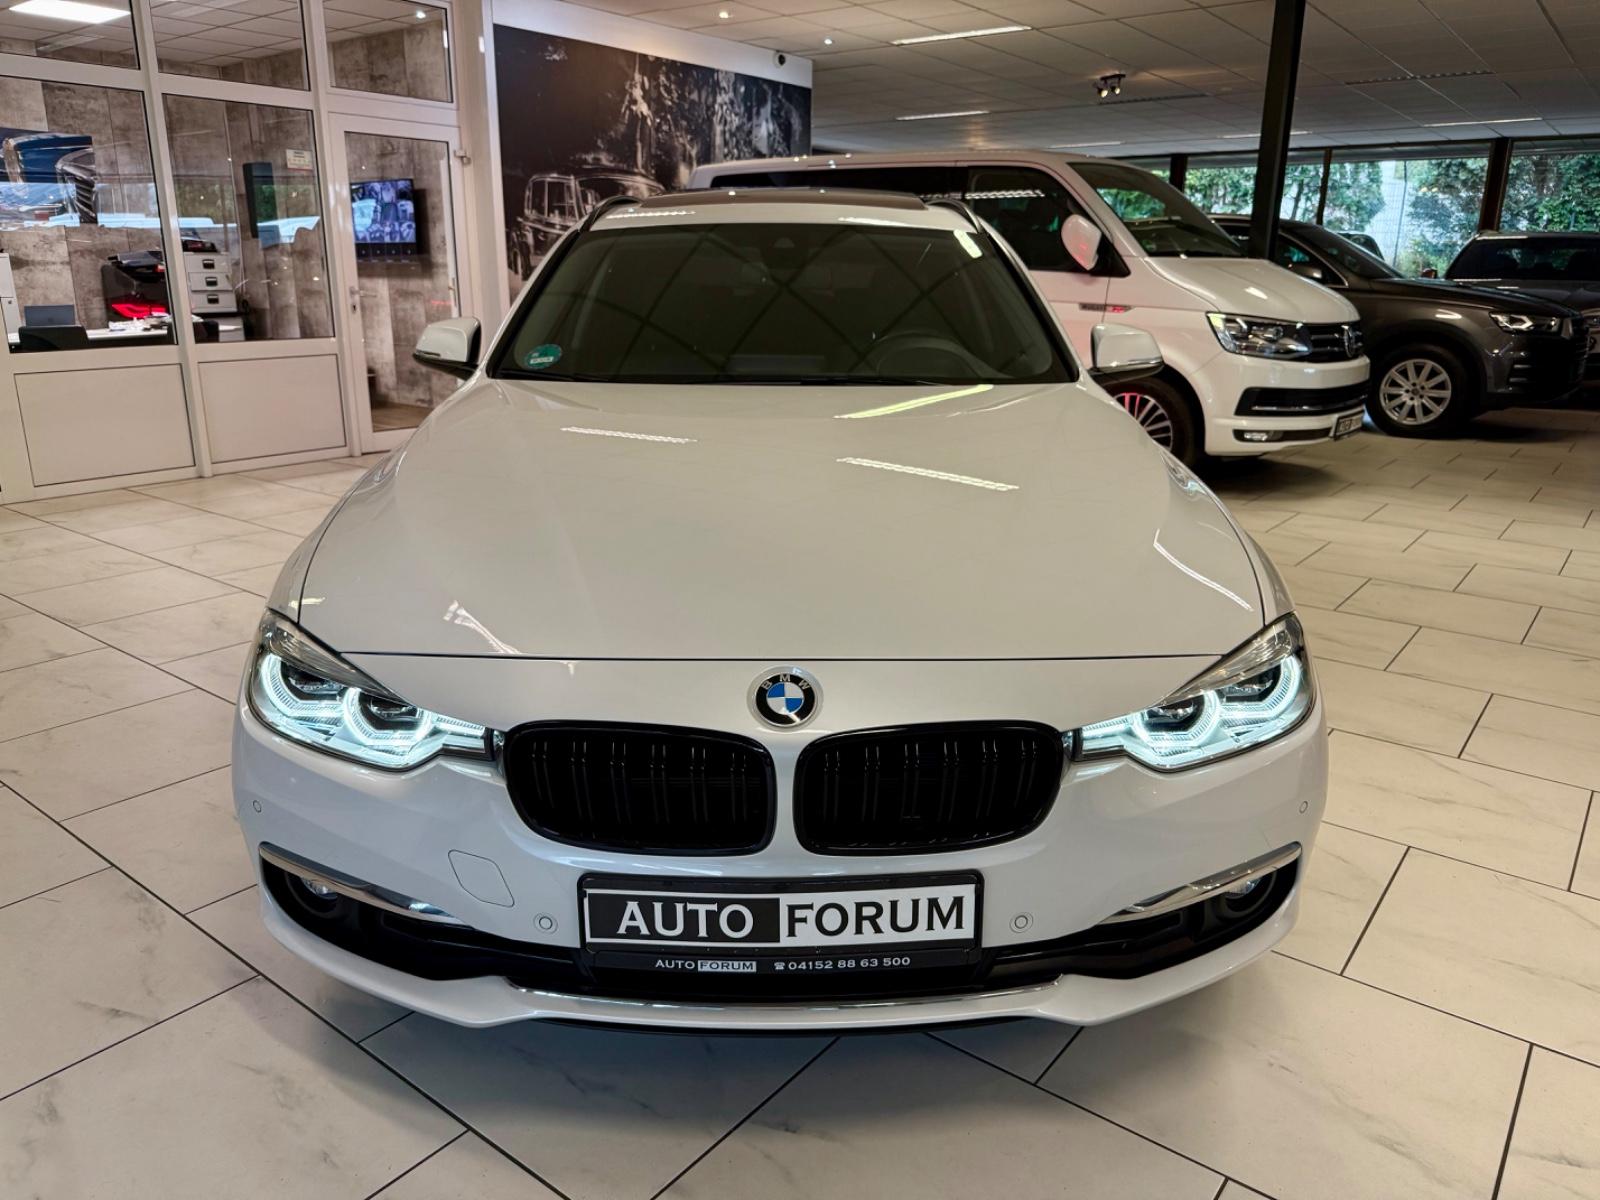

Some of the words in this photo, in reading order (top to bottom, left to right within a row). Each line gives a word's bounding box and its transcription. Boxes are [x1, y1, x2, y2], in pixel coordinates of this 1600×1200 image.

[760, 673, 811, 690] BMW
[617, 901, 754, 939] AUTO
[785, 896, 964, 938] FORUM
[655, 959, 695, 970] AUTO
[698, 961, 755, 972] FORUM
[787, 959, 834, 971] 04152
[837, 958, 856, 969] 88
[859, 958, 878, 968] 63
[882, 957, 911, 967] 500
